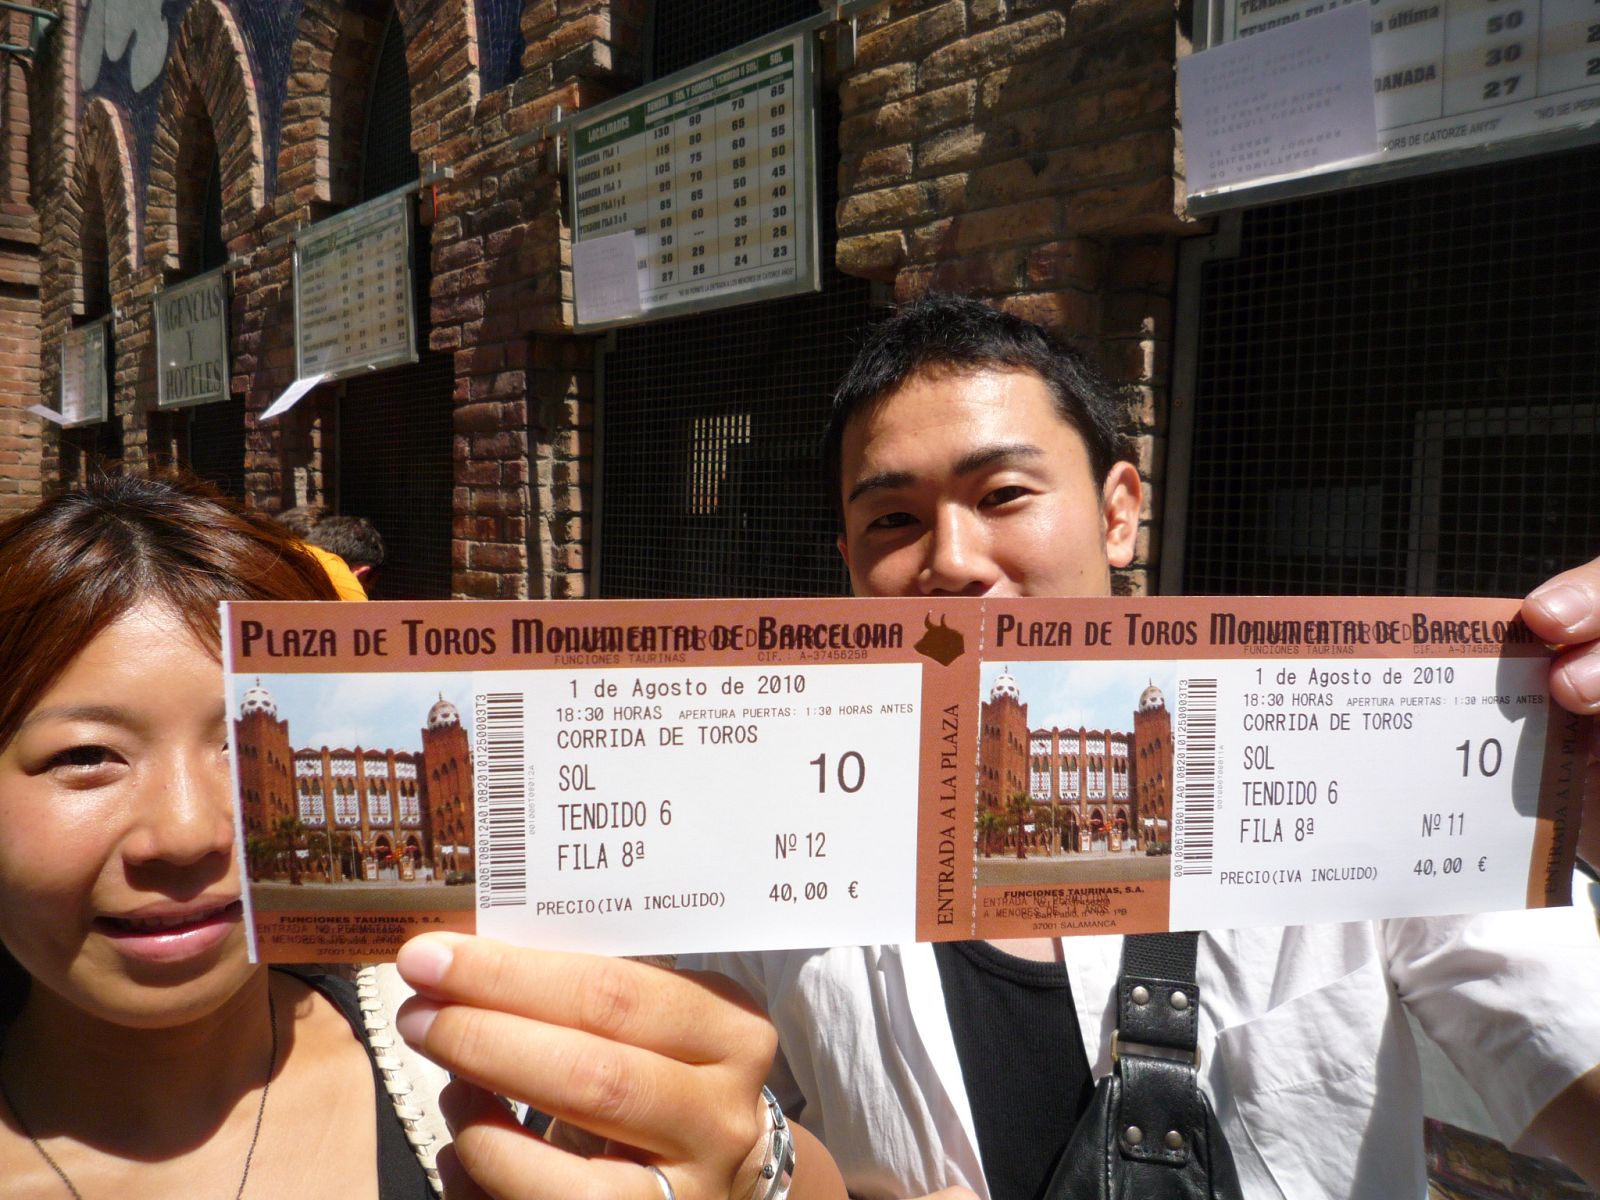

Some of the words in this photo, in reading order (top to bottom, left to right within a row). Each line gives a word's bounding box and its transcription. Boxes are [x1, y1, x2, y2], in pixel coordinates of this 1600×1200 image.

[1487, 10, 1523, 34] 50
[1485, 43, 1522, 67] 30
[1483, 76, 1521, 100] 27
[654, 126, 669, 139] 130
[732, 99, 744, 111] 70
[770, 84, 785, 97] 65
[656, 145, 670, 156] 115
[732, 118, 745, 130] 65
[771, 104, 785, 117] 60
[1408, 134, 1420, 147] DE
[1423, 124, 1467, 143] CATORZE
[655, 162, 670, 176] 105
[690, 152, 702, 164] 75
[732, 137, 745, 150] 60
[771, 125, 785, 138] 55
[690, 170, 702, 182] 70
[733, 157, 746, 170] 55
[772, 145, 786, 158] 50
[691, 189, 703, 201] 65
[733, 177, 746, 189] 50
[772, 165, 786, 178] 45
[692, 208, 703, 220] 60
[734, 196, 747, 208] 45
[772, 185, 786, 198] 40
[661, 235, 672, 246] 50
[734, 216, 747, 228] 35
[772, 206, 786, 218] 30
[662, 253, 673, 264] 30
[734, 235, 747, 248] 27
[662, 270, 674, 282] 27
[734, 255, 748, 266] 24
[773, 246, 787, 258] 23
[162, 285, 221, 334] AGENCIAS
[186, 329, 194, 361] Y
[165, 360, 222, 401] HOTELES
[240, 619, 337, 657] PLAZA
[354, 628, 388, 656] DE
[401, 618, 497, 656] TOROS
[511, 618, 701, 654] MONUMENTAL
[713, 624, 744, 650] DE
[758, 616, 904, 651] BARCELONA
[996, 613, 1072, 647] PLAZA
[1085, 621, 1112, 645] DE
[1124, 613, 1198, 645] TOROS
[1210, 612, 1365, 645] MONUMENTAL
[1375, 620, 1400, 645] DE
[554, 654, 620, 665] FUNCIONES
[628, 653, 686, 664] TAURINAS
[1243, 645, 1300, 655] FUNCIONES
[1307, 644, 1354, 655] TAURINAS
[569, 680, 577, 698] 1
[595, 679, 618, 697] de
[632, 677, 708, 700] Agosto
[721, 676, 744, 696] de
[757, 674, 806, 695] 2010
[1255, 668, 1263, 685] 1
[1276, 668, 1296, 685] de
[1308, 668, 1372, 687] Agosto
[1383, 667, 1403, 684] de
[1413, 667, 1455, 684] 2010
[556, 707, 604, 722] 18:30
[614, 706, 663, 720] HORAS
[679, 708, 736, 720] APERTURA
[742, 706, 797, 718] PUERTAS:
[806, 706, 832, 717] 1:30
[839, 705, 873, 715] HORAS
[880, 703, 914, 715] ANTES
[1243, 694, 1285, 707] 18:30
[1292, 693, 1333, 706] HORAS
[1347, 697, 1395, 707] APERTURA
[1400, 697, 1446, 706] PUERTAS:
[1453, 696, 1476, 706] 1:30
[1481, 695, 1510, 705] HORAS
[1516, 695, 1545, 705] ANTES
[557, 729, 646, 749] CORRIDA
[659, 728, 683, 746] DE
[698, 725, 758, 744] TOROS
[940, 704, 959, 769] PLAZA
[1243, 713, 1319, 731] CORRIDA
[1330, 713, 1350, 730] DE
[1363, 712, 1413, 730] TOROS
[1561, 712, 1579, 755] PLAZ
[558, 764, 596, 791] SOL
[809, 751, 866, 794] 10
[1243, 745, 1275, 770] SOL
[1456, 738, 1503, 778] 10
[1558, 761, 1573, 783] LA
[940, 775, 957, 801] LA
[1242, 781, 1317, 806] TENDIDO
[1327, 780, 1338, 805] 6
[558, 803, 646, 831] TENDIDO
[660, 800, 672, 825] 6
[940, 807, 955, 820] A
[1240, 818, 1283, 843] FILA
[1294, 817, 1314, 842] 8ª
[1421, 813, 1441, 838] Nº
[1448, 812, 1465, 836] 11
[558, 843, 608, 871] FILA
[622, 840, 645, 867] 8ª
[775, 832, 797, 860] Nº
[806, 831, 826, 858] 12
[1545, 806, 1568, 894] ENTRADA
[937, 826, 955, 925] ENTRADA
[1220, 870, 1302, 885] PRECIO(IVA
[1312, 866, 1378, 883] INCLUIDO)
[1477, 856, 1487, 873] €
[537, 897, 633, 916] PRECIO(IVA
[644, 892, 726, 912] INCLUIDO)
[848, 881, 859, 899] €
[983, 897, 1028, 908] ENTRADA
[1004, 889, 1064, 898] FUNCIONES
[1068, 887, 1123, 896] TAURINAS,
[1060, 919, 1116, 929] SALAMANCA
